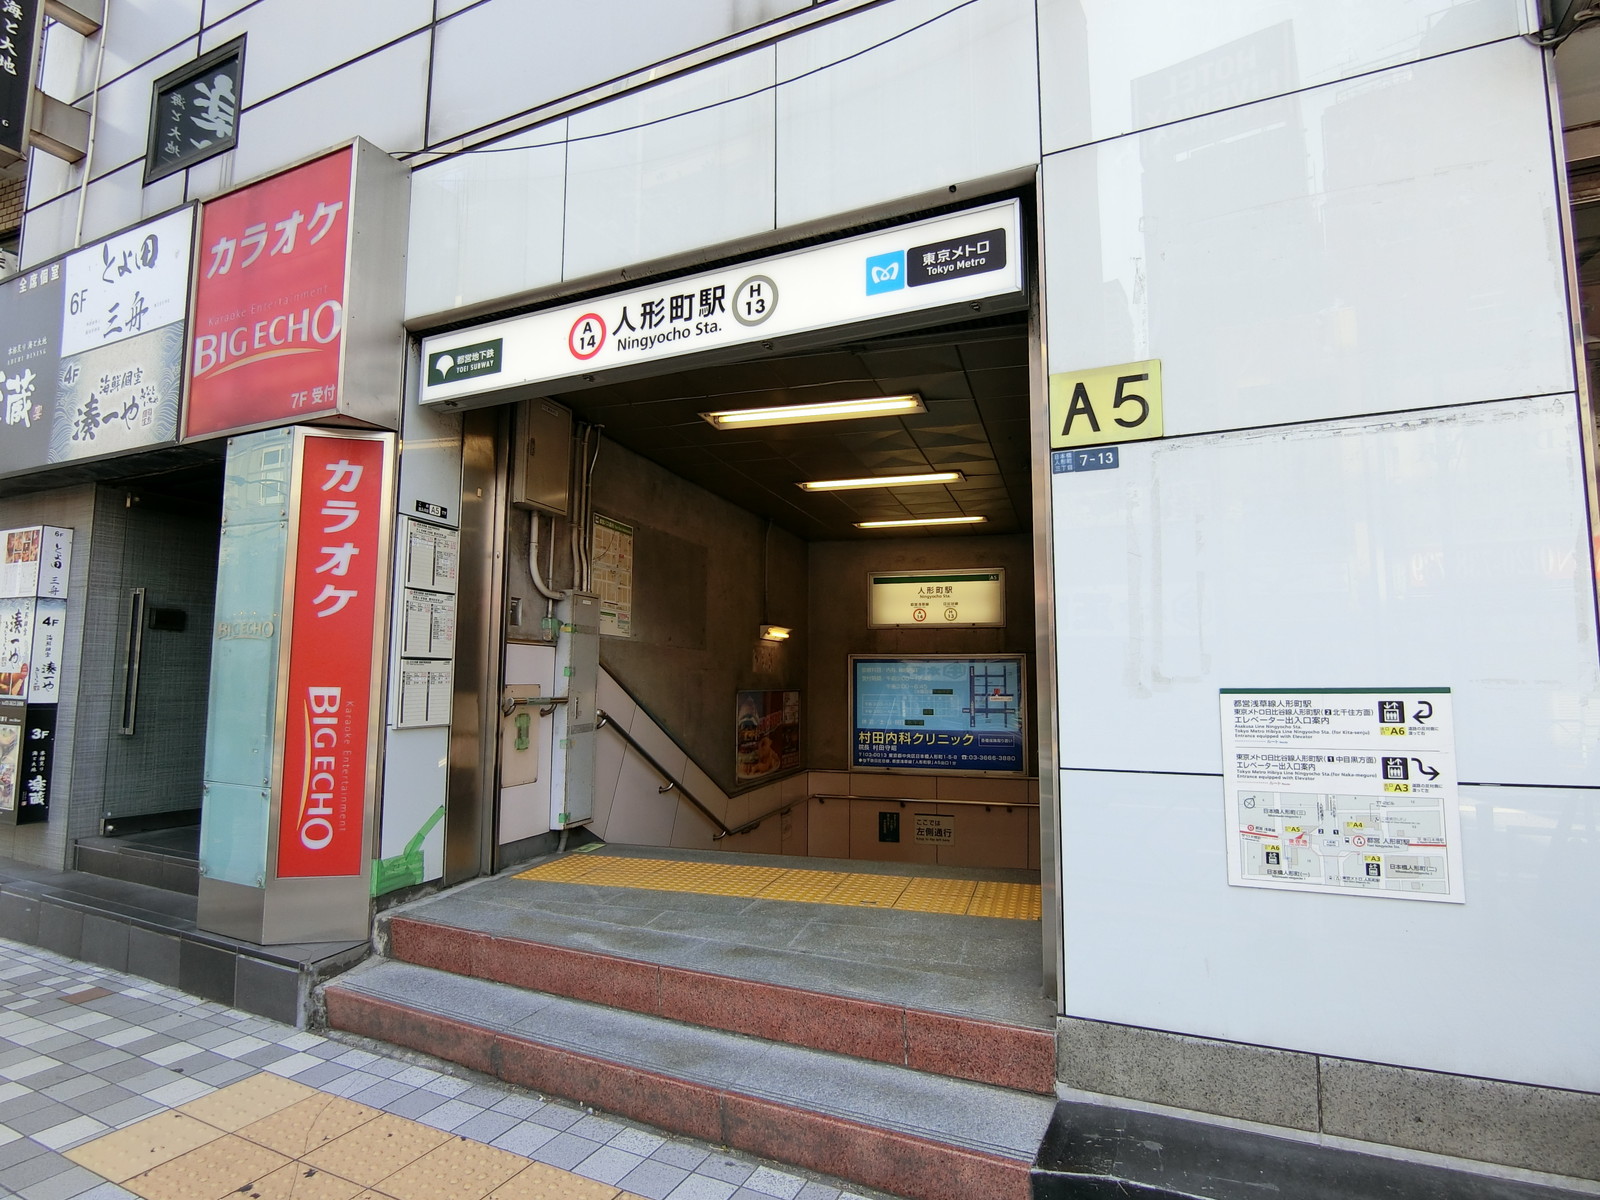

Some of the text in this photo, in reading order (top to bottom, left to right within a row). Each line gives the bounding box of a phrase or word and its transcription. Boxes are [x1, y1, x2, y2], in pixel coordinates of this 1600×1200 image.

[206, 201, 343, 280] カラオケ
[922, 240, 990, 267] 東京メトロ
[927, 257, 986, 276] Tokyo Metro
[19, 264, 60, 293] 全席個室
[750, 283, 761, 298] H
[70, 289, 88, 316] 6F
[208, 284, 328, 327] Karaoke Entertainment
[612, 285, 726, 336] 人形町駅
[746, 299, 765, 316] 13
[103, 291, 149, 338] 三舟
[583, 321, 592, 334] A
[193, 300, 344, 378] BIG ECHO
[580, 335, 596, 350] 14
[617, 321, 722, 351] Ningyocho Sta.
[457, 349, 495, 365] 都営地下鉄
[456, 360, 494, 374] TOEI SUBWAY
[64, 366, 80, 385] 4F
[99, 367, 143, 395] 海鮮個室
[291, 385, 336, 409] 7F 受付
[1062, 372, 1150, 437] A5
[1054, 452, 1072, 460] 日本橋
[1079, 452, 1114, 466] 7-13
[430, 506, 440, 515] A5
[312, 459, 364, 618] カラオケ
[918, 586, 953, 595] 人形町駅
[42, 616, 60, 627] 4F
[241, 619, 275, 638] ECHO
[1233, 700, 1312, 708] 都営浅草線人形町駅
[1234, 716, 1330, 725] エレベーター出入口案内
[31, 728, 50, 740] 3F
[858, 731, 974, 746] 村田内科クリニック
[1390, 727, 1405, 735] A6
[301, 686, 341, 850] BIG ECHO
[339, 701, 354, 832] Karaoke Entertainment
[1237, 761, 1316, 771] エレベーター出入口案内
[1394, 784, 1409, 792] A3
[916, 819, 941, 827] ここでは
[916, 827, 952, 838] 左側通行
